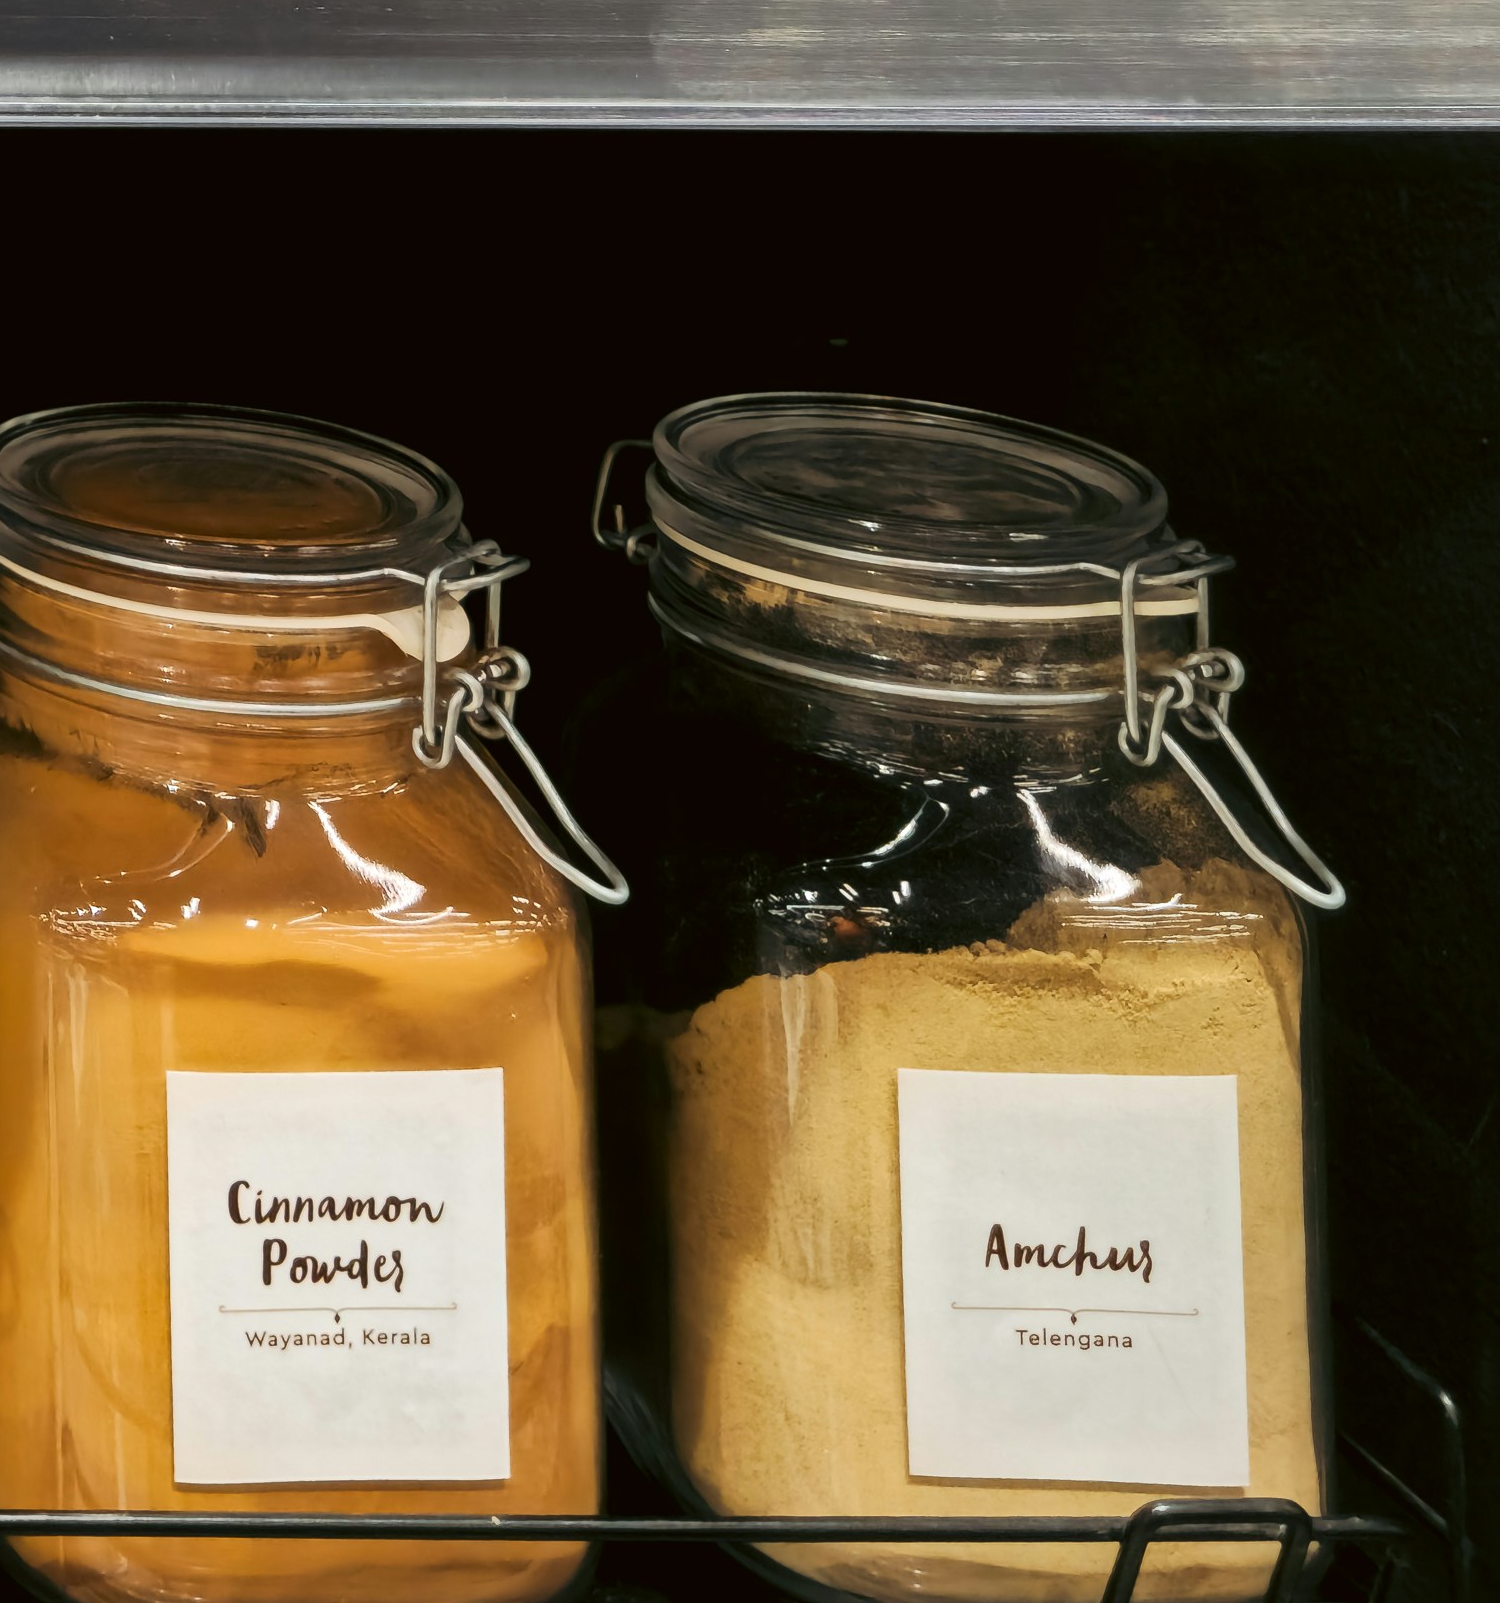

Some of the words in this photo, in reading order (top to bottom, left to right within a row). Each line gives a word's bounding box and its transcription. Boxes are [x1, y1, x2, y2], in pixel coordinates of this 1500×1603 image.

[228, 1180, 444, 1225] Cinnamon
[262, 1238, 404, 1293] Powder
[985, 1224, 1152, 1283] Amchur
[245, 1327, 353, 1353] Wayanad,
[363, 1327, 432, 1346] Kerala
[1015, 1328, 1132, 1350] Telengana
